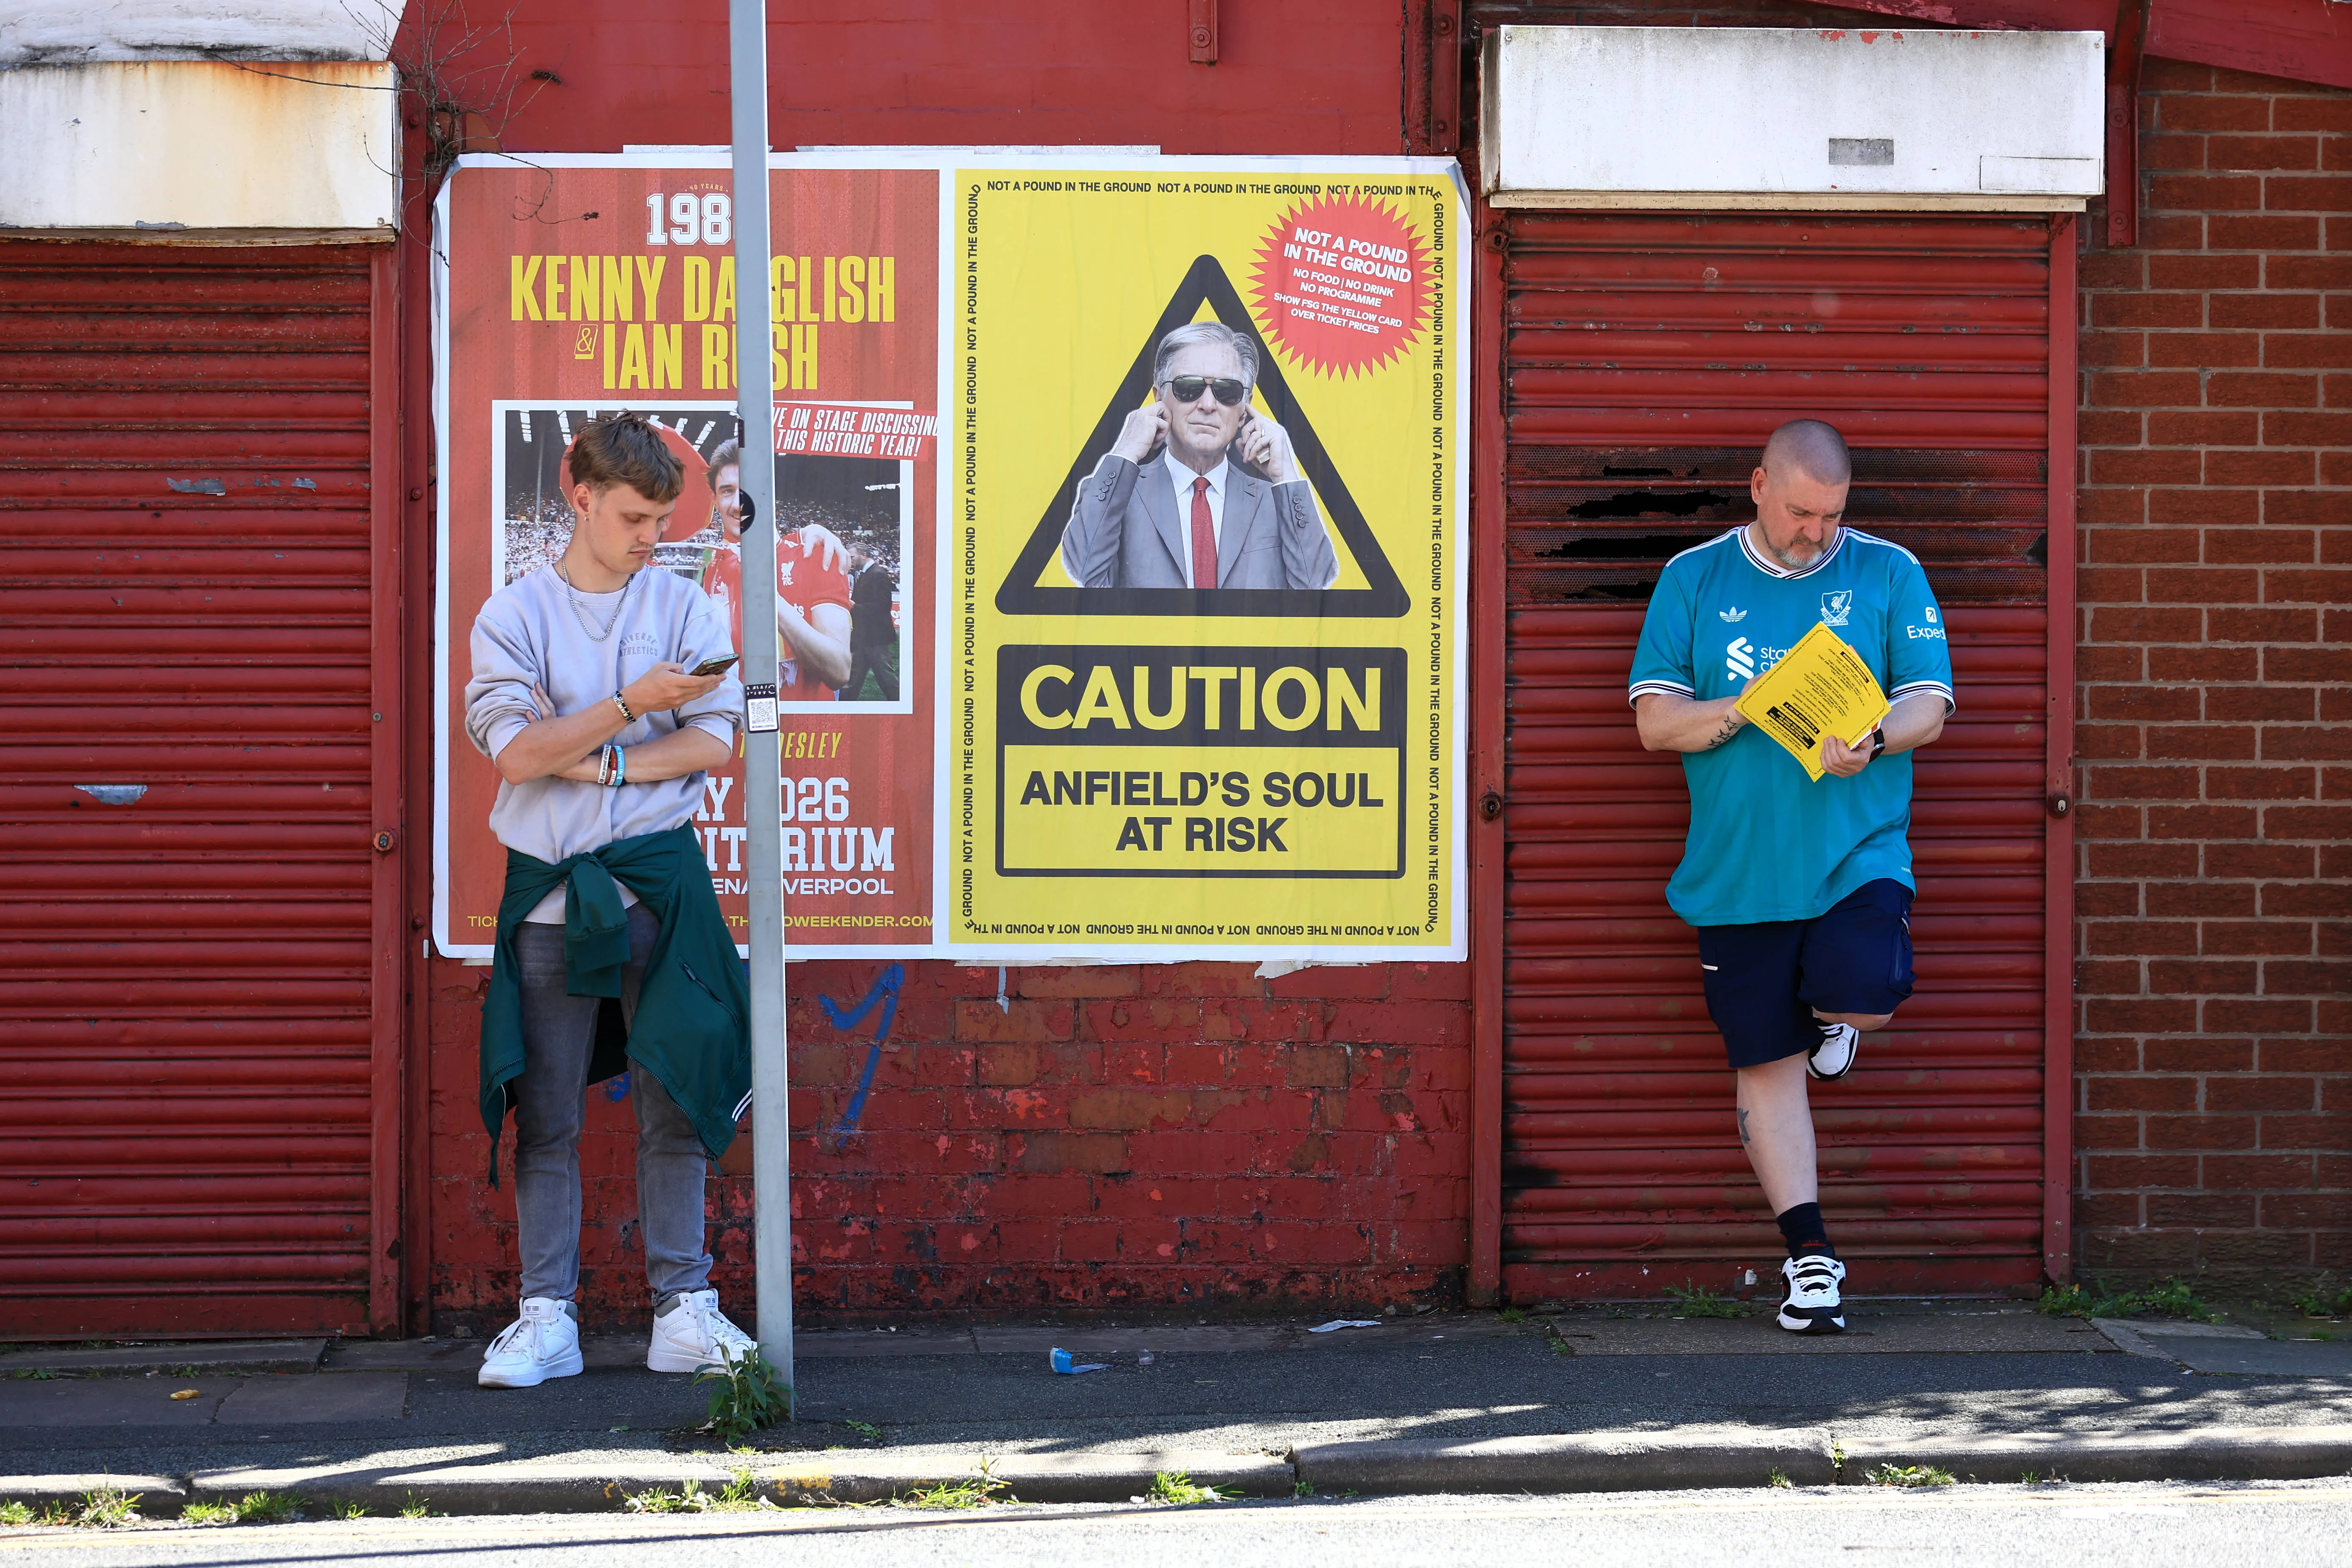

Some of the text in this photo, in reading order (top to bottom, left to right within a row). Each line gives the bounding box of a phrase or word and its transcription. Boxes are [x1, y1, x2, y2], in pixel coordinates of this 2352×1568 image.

[701, 183, 723, 191] YEARS
[988, 181, 1443, 201] NOT A POUND IN THE GROUND NOT A POUND IN THE GROUND NOT A POUND IN THE
[647, 193, 734, 245] 198
[1434, 204, 1444, 251] GROUND
[1295, 227, 1408, 264] NOT A POUND
[1284, 243, 1412, 283] IN THE GROUND
[1434, 257, 1444, 281] NOT
[511, 255, 895, 322] KENNY DAGLISH
[1293, 268, 1395, 298] NO FOOD NO DRINK
[1300, 282, 1382, 308] NO PROGRAMME
[1274, 292, 1402, 328] SHOW FSG THE YELLOW CARD
[1291, 309, 1380, 334] OVER TICKET PRICES
[1434, 293, 1444, 332] POUND
[1434, 335, 1443, 346] IN
[603, 323, 818, 390] IAN RSH
[1434, 348, 1443, 370] THE
[1433, 373, 1443, 422] GROUND
[791, 408, 811, 429] ON
[814, 410, 858, 432] STAGE
[776, 430, 922, 457] THIS HISTORIC YEAR!
[1433, 427, 1443, 450] NOT
[1433, 452, 1443, 460] A
[1433, 463, 1443, 502] POUND
[1433, 505, 1442, 515] IN
[1432, 518, 1442, 540] THE
[1432, 543, 1442, 592] GROUND
[1431, 598, 1442, 620] NOT
[1431, 623, 1441, 631] A
[620, 632, 657, 647] DIVERSE
[620, 647, 658, 658] ATHLETICS
[1431, 633, 1441, 672] POUND
[1760, 646, 1791, 660] sta
[746, 684, 775, 696] MWC
[1431, 675, 1440, 686] IN
[1020, 664, 1381, 731] CAUTION
[1431, 689, 1440, 711] THE
[1430, 713, 1440, 762] GROUND
[1263, 772, 1384, 808] SOUL
[1429, 768, 1439, 791] NOT
[1430, 793, 1439, 801] A
[1116, 816, 1288, 852] AT RISK
[1429, 803, 1439, 842] POUND
[1429, 845, 1439, 856] IN
[1429, 859, 1439, 881] THE
[1425, 883, 1439, 933] GROUND
[964, 919, 1420, 936] NOT A POUND IN THE GROUND NOT A POUND IN THE GROUND NOT A POUND IN THE
